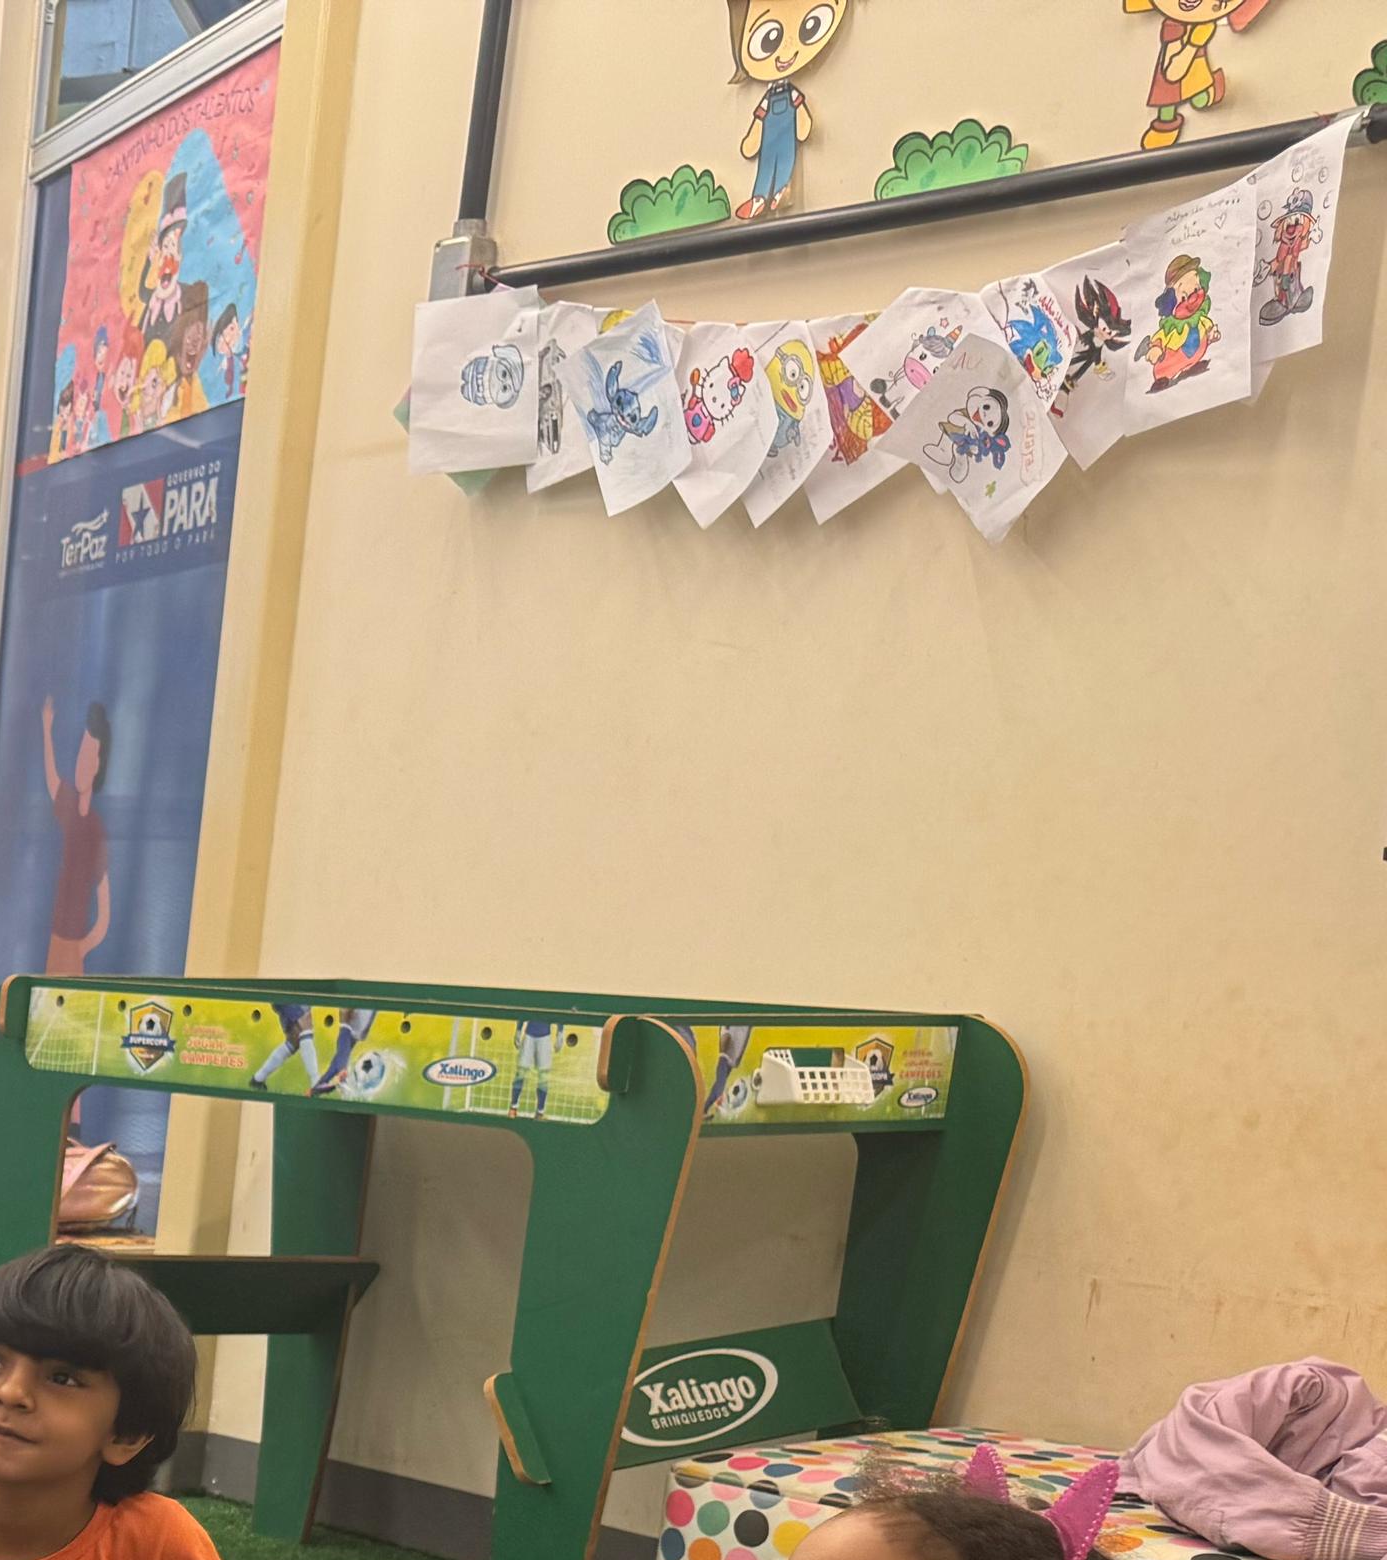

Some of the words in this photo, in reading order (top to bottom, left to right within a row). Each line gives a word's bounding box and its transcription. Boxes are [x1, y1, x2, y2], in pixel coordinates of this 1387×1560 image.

[167, 465, 205, 487] GOVERNO
[208, 460, 222, 475] DO
[439, 1063, 485, 1080] Xalingo
[640, 1375, 757, 1416] Xalingo
[651, 1406, 730, 1430] BRINQUEDOS
